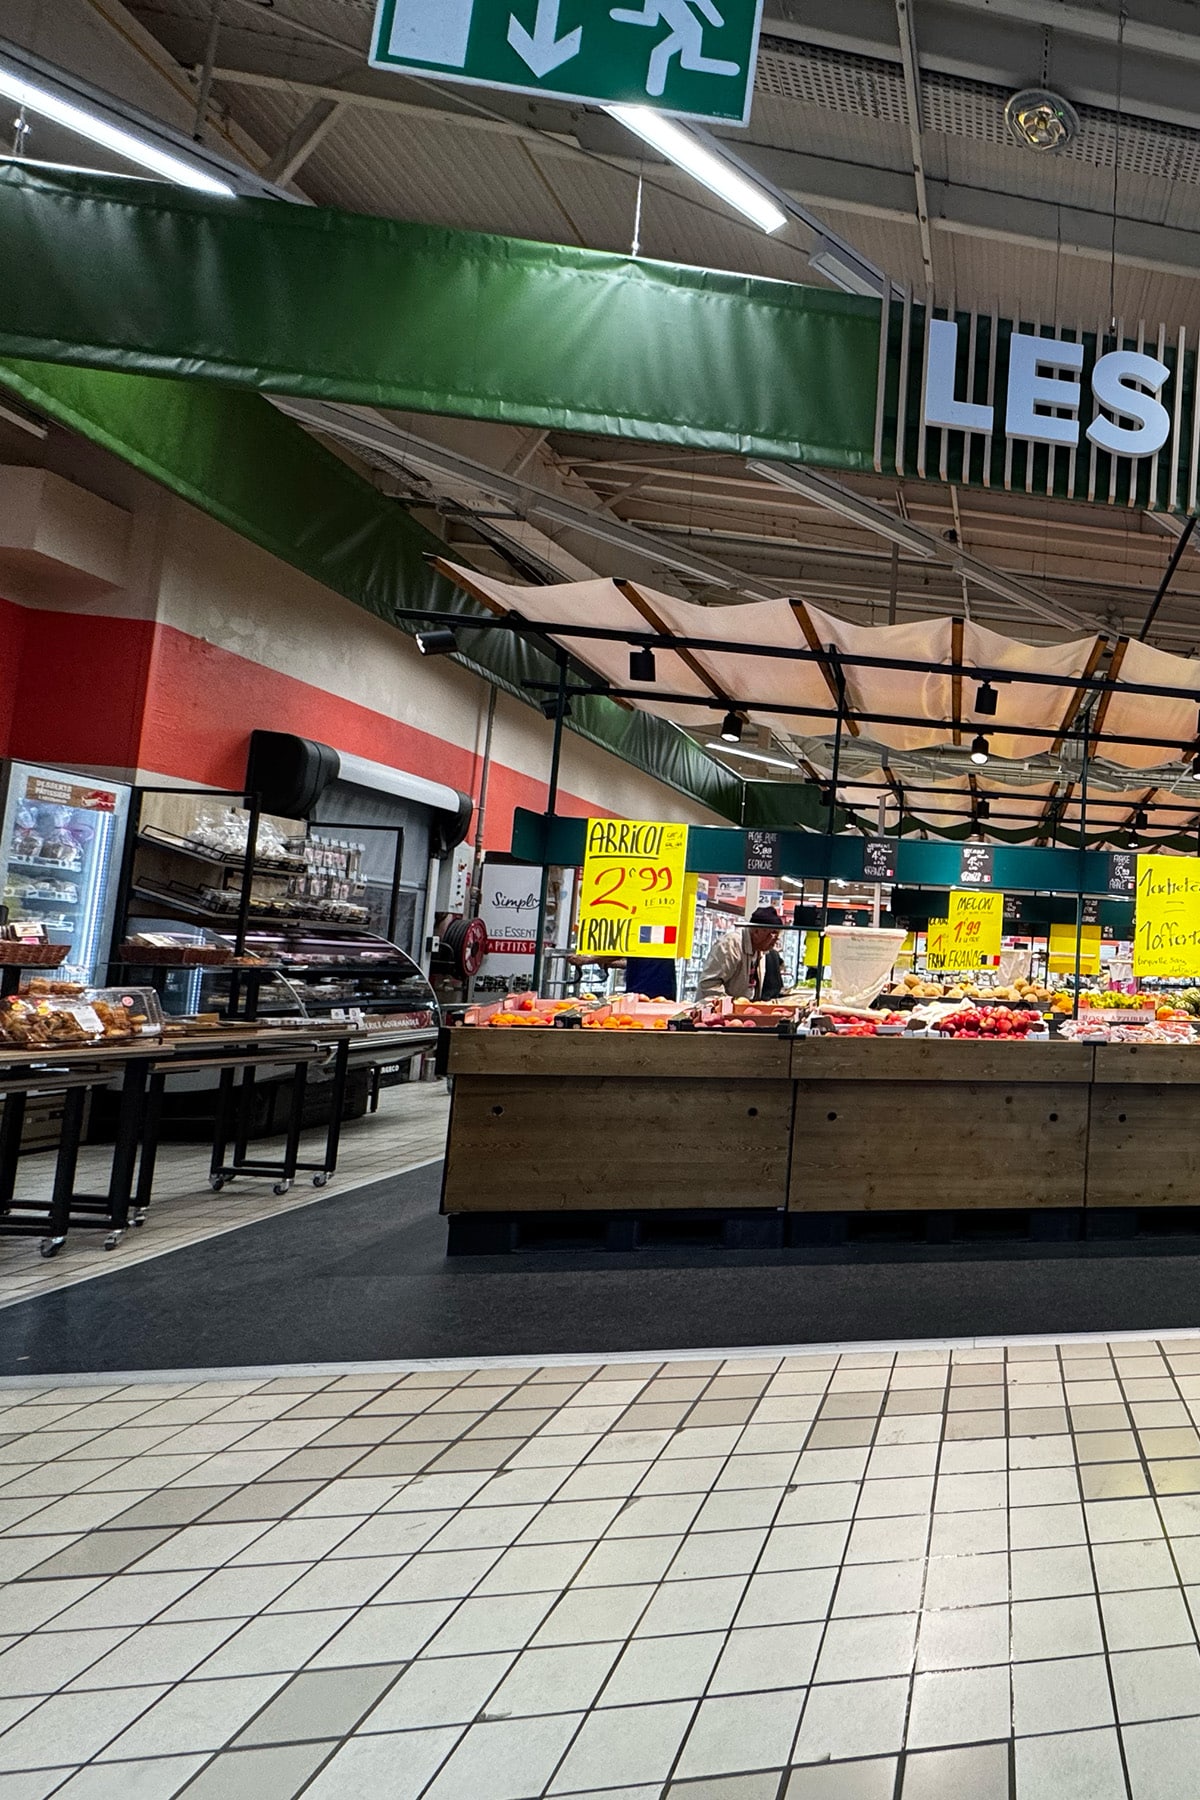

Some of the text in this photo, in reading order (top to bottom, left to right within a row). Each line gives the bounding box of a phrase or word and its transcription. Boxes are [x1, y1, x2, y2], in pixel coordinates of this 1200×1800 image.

[925, 319, 1170, 458] LES
[957, 897, 994, 910] MELON
[490, 926, 537, 938] LES ESSENT
[495, 941, 527, 952] PETITS
[948, 951, 984, 968] FRANCE
